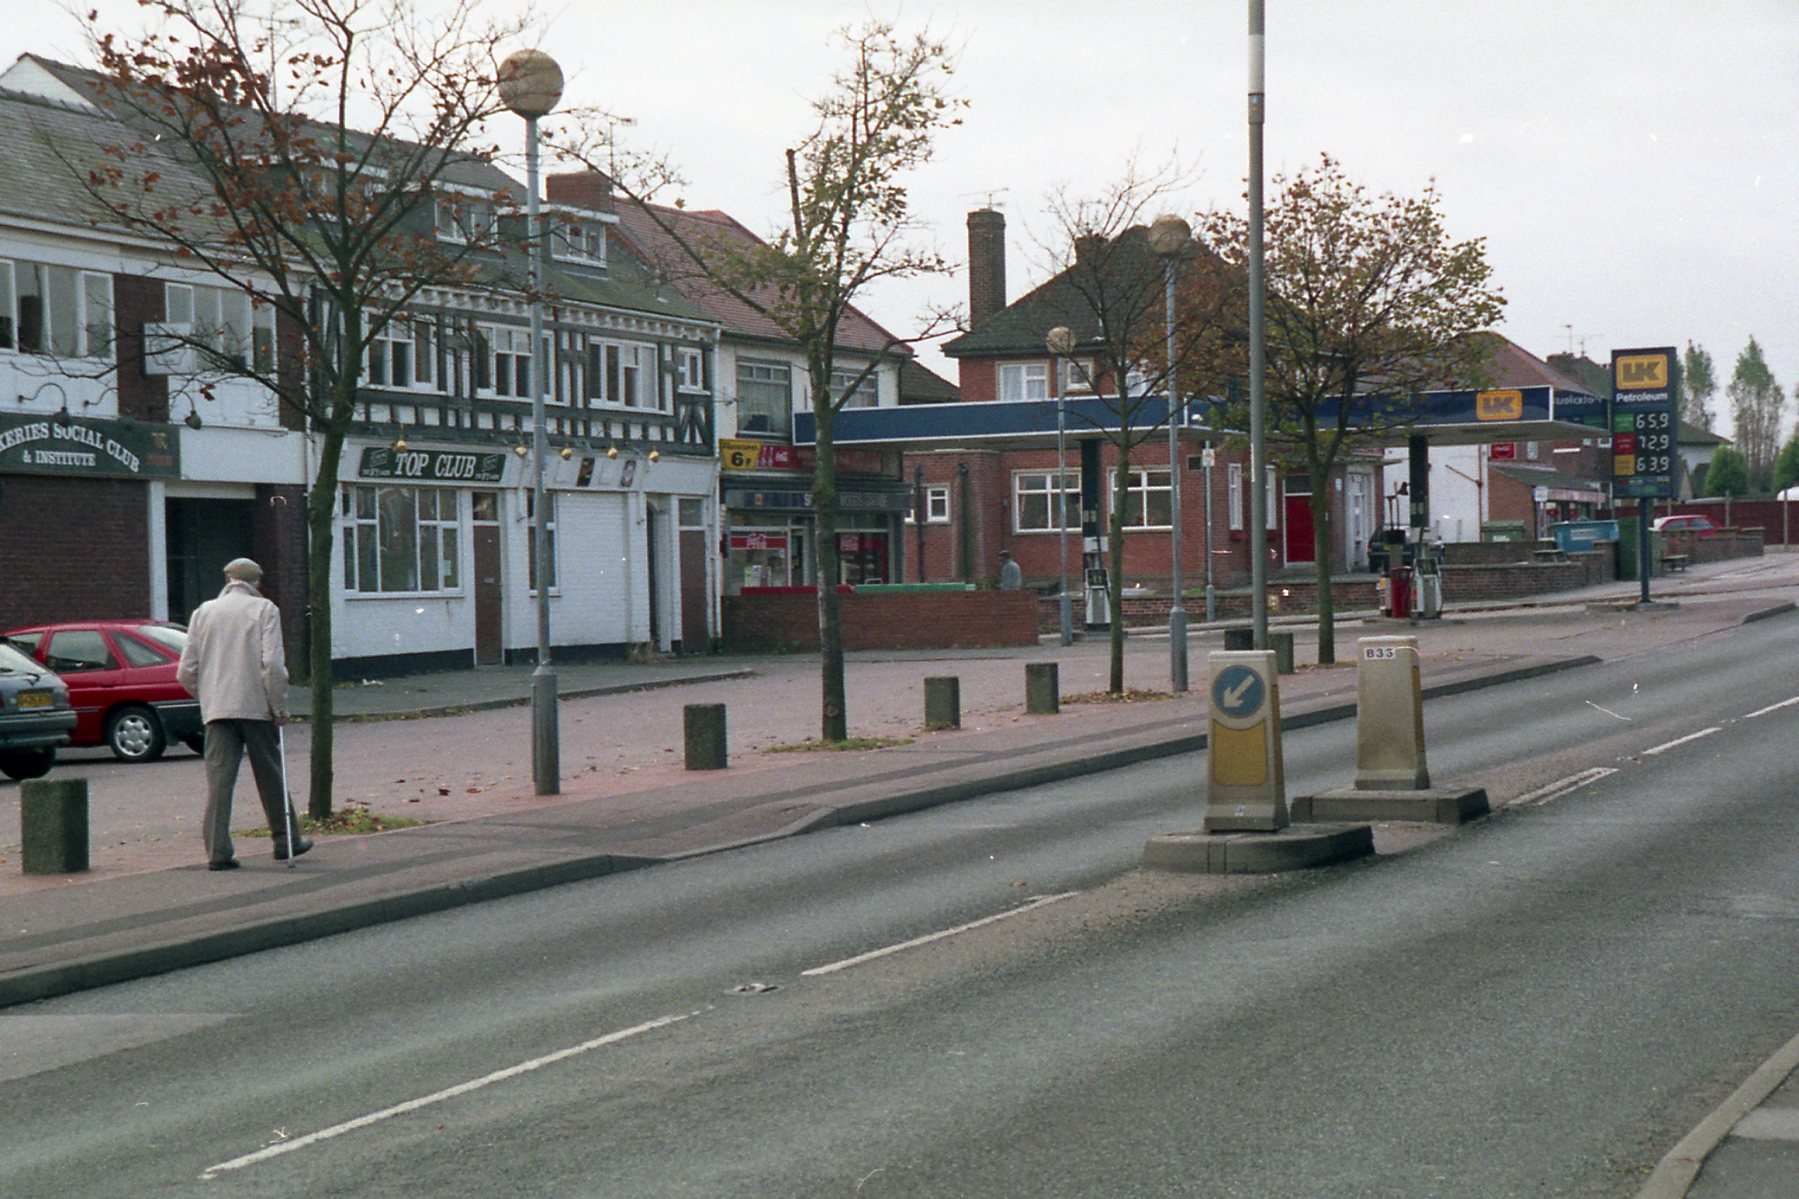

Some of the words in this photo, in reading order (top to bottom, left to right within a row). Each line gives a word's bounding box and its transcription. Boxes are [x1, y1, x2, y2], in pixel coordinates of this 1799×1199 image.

[1622, 361, 1660, 383] UK
[1616, 392, 1668, 403] Petroleum
[23, 450, 32, 464] &
[36, 450, 96, 466] INSTITUTE
[53, 423, 104, 449] SOCIAL
[106, 439, 140, 473] CLUB
[394, 452, 430, 477] TOP
[434, 454, 477, 478] CLUB
